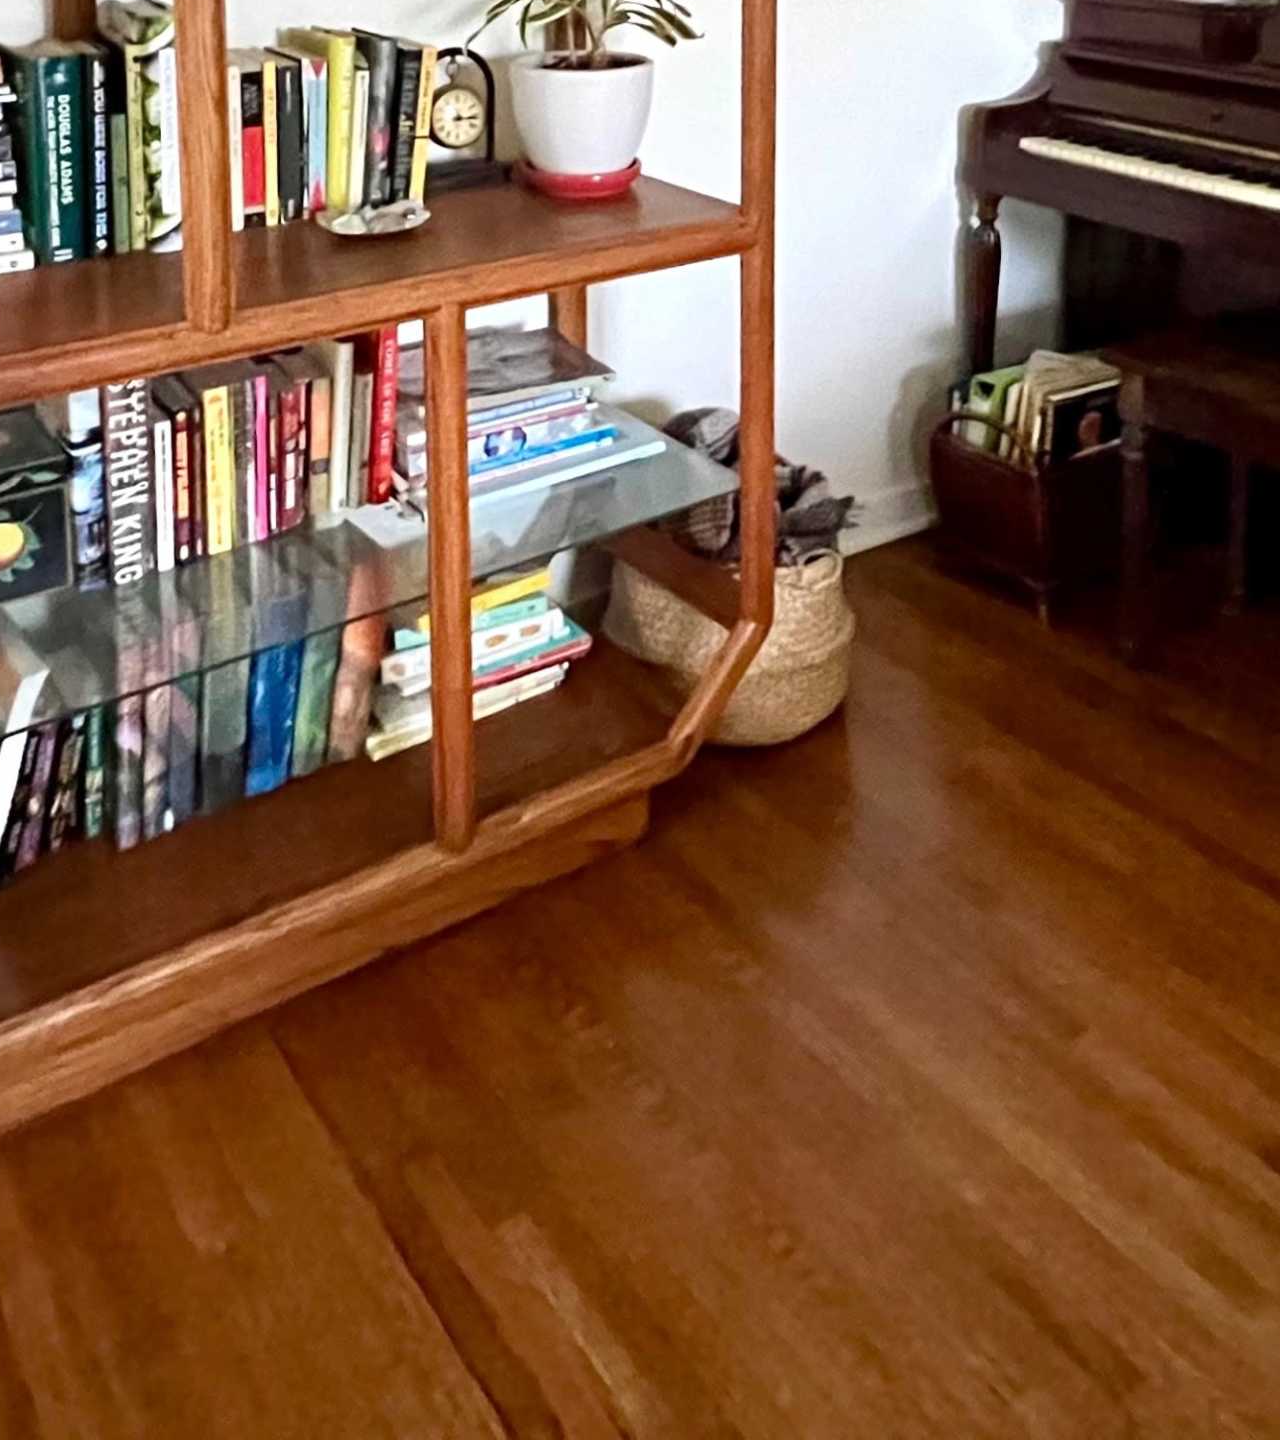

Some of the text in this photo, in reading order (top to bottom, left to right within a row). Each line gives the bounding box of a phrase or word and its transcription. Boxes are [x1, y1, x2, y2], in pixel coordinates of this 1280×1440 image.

[93, 88, 106, 113] YOU
[58, 94, 74, 205] DOUGLAS ADAMS
[112, 513, 144, 585] KING
